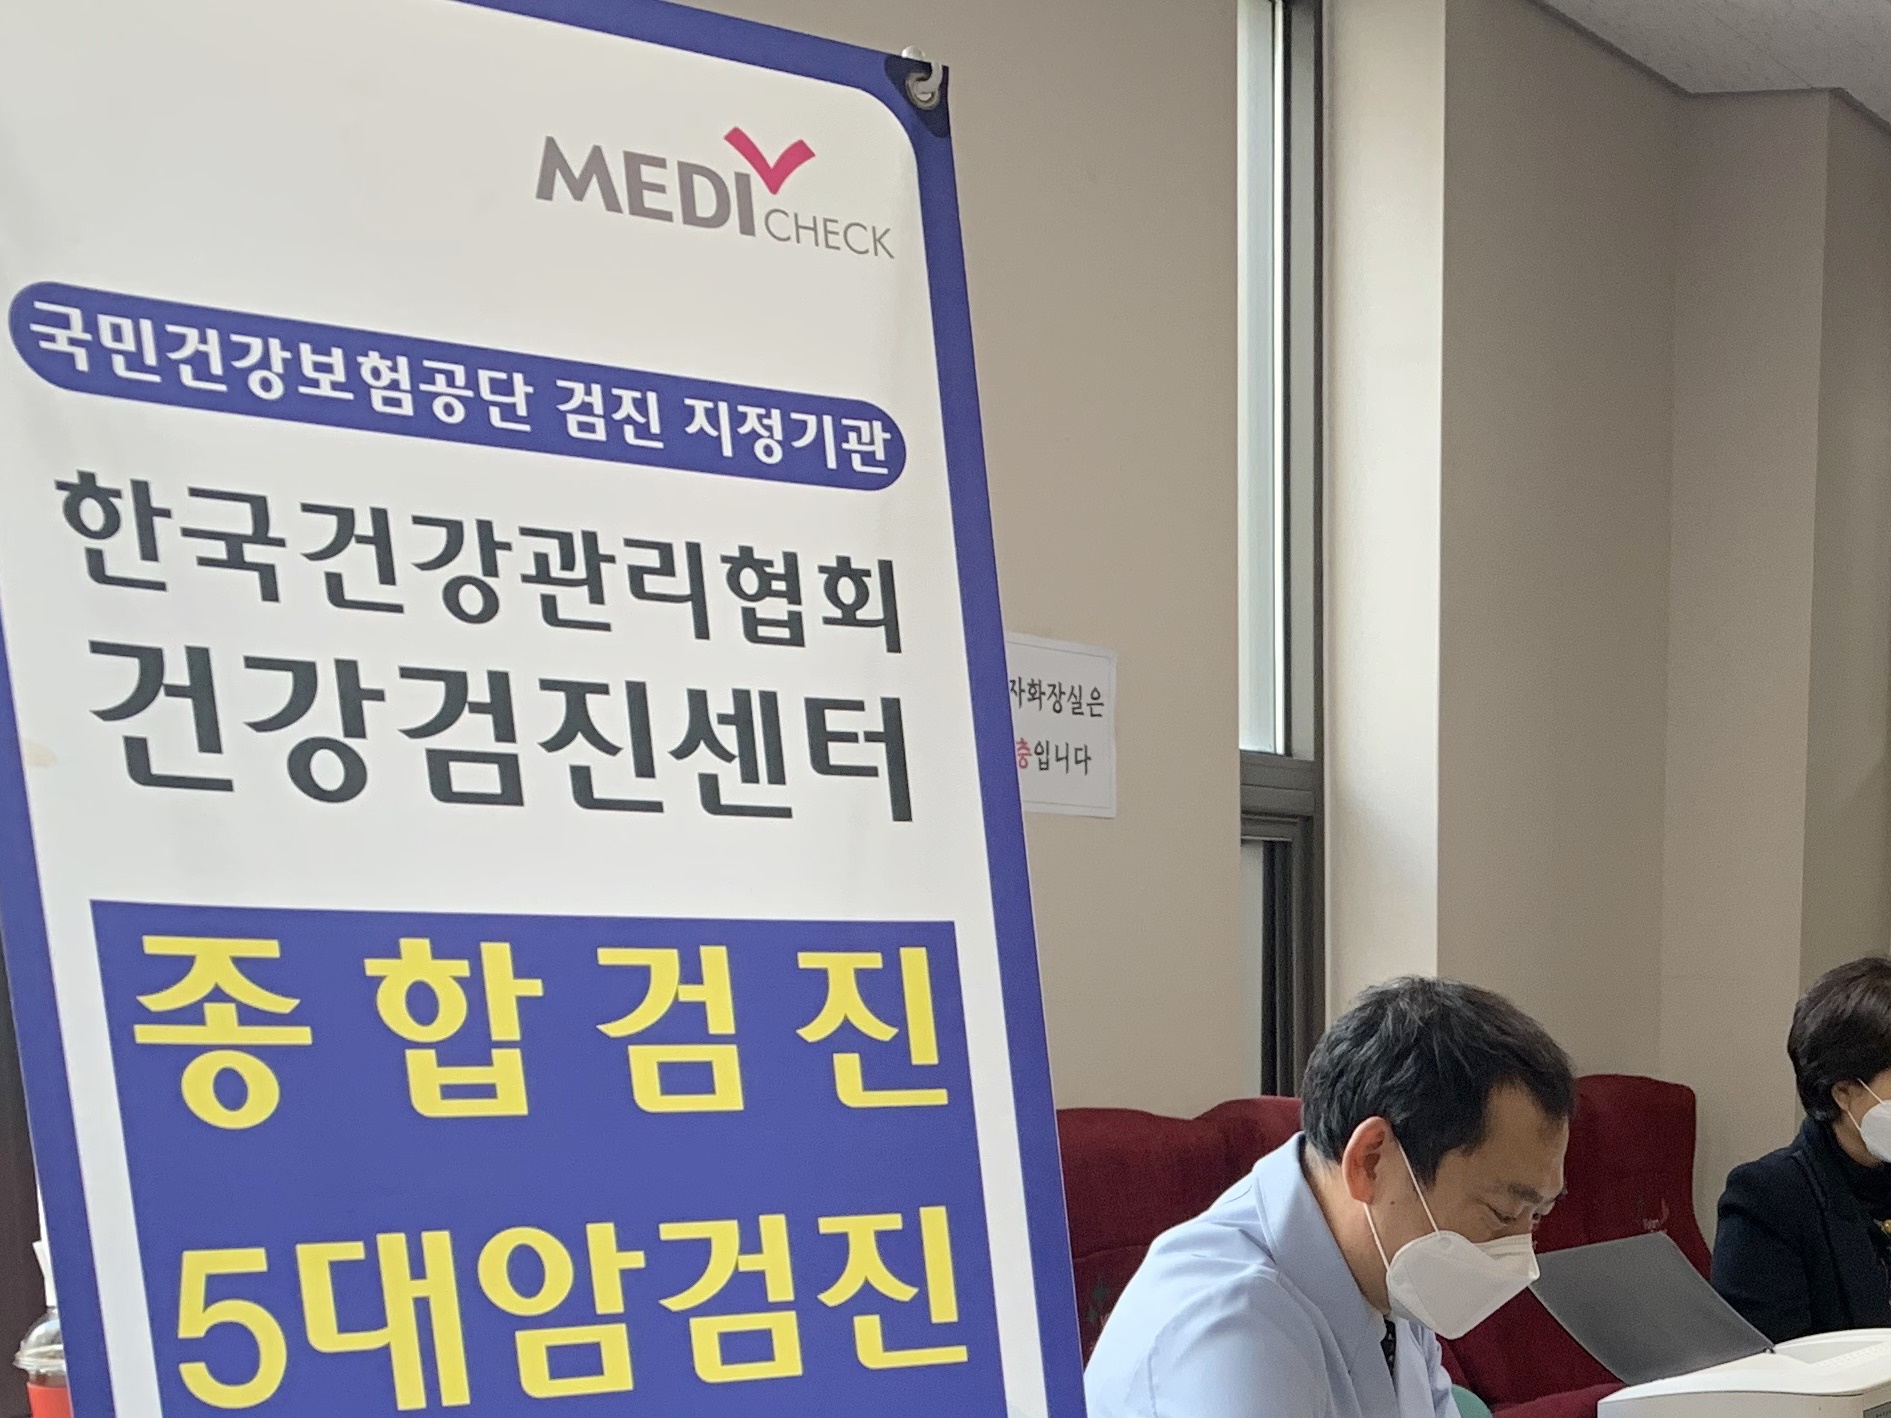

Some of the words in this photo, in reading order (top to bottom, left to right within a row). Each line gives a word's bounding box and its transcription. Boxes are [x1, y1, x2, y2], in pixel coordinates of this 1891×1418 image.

[535, 135, 756, 237] MEDI
[764, 208, 895, 259] CHECK
[29, 299, 535, 432] 국민건강보험공단
[556, 376, 665, 450] 검진
[684, 395, 891, 475] 지정기관
[54, 468, 903, 654] 한국건강관리협회
[89, 638, 914, 822] 건강검진센터
[176, 1205, 969, 1411] 5대암검진
